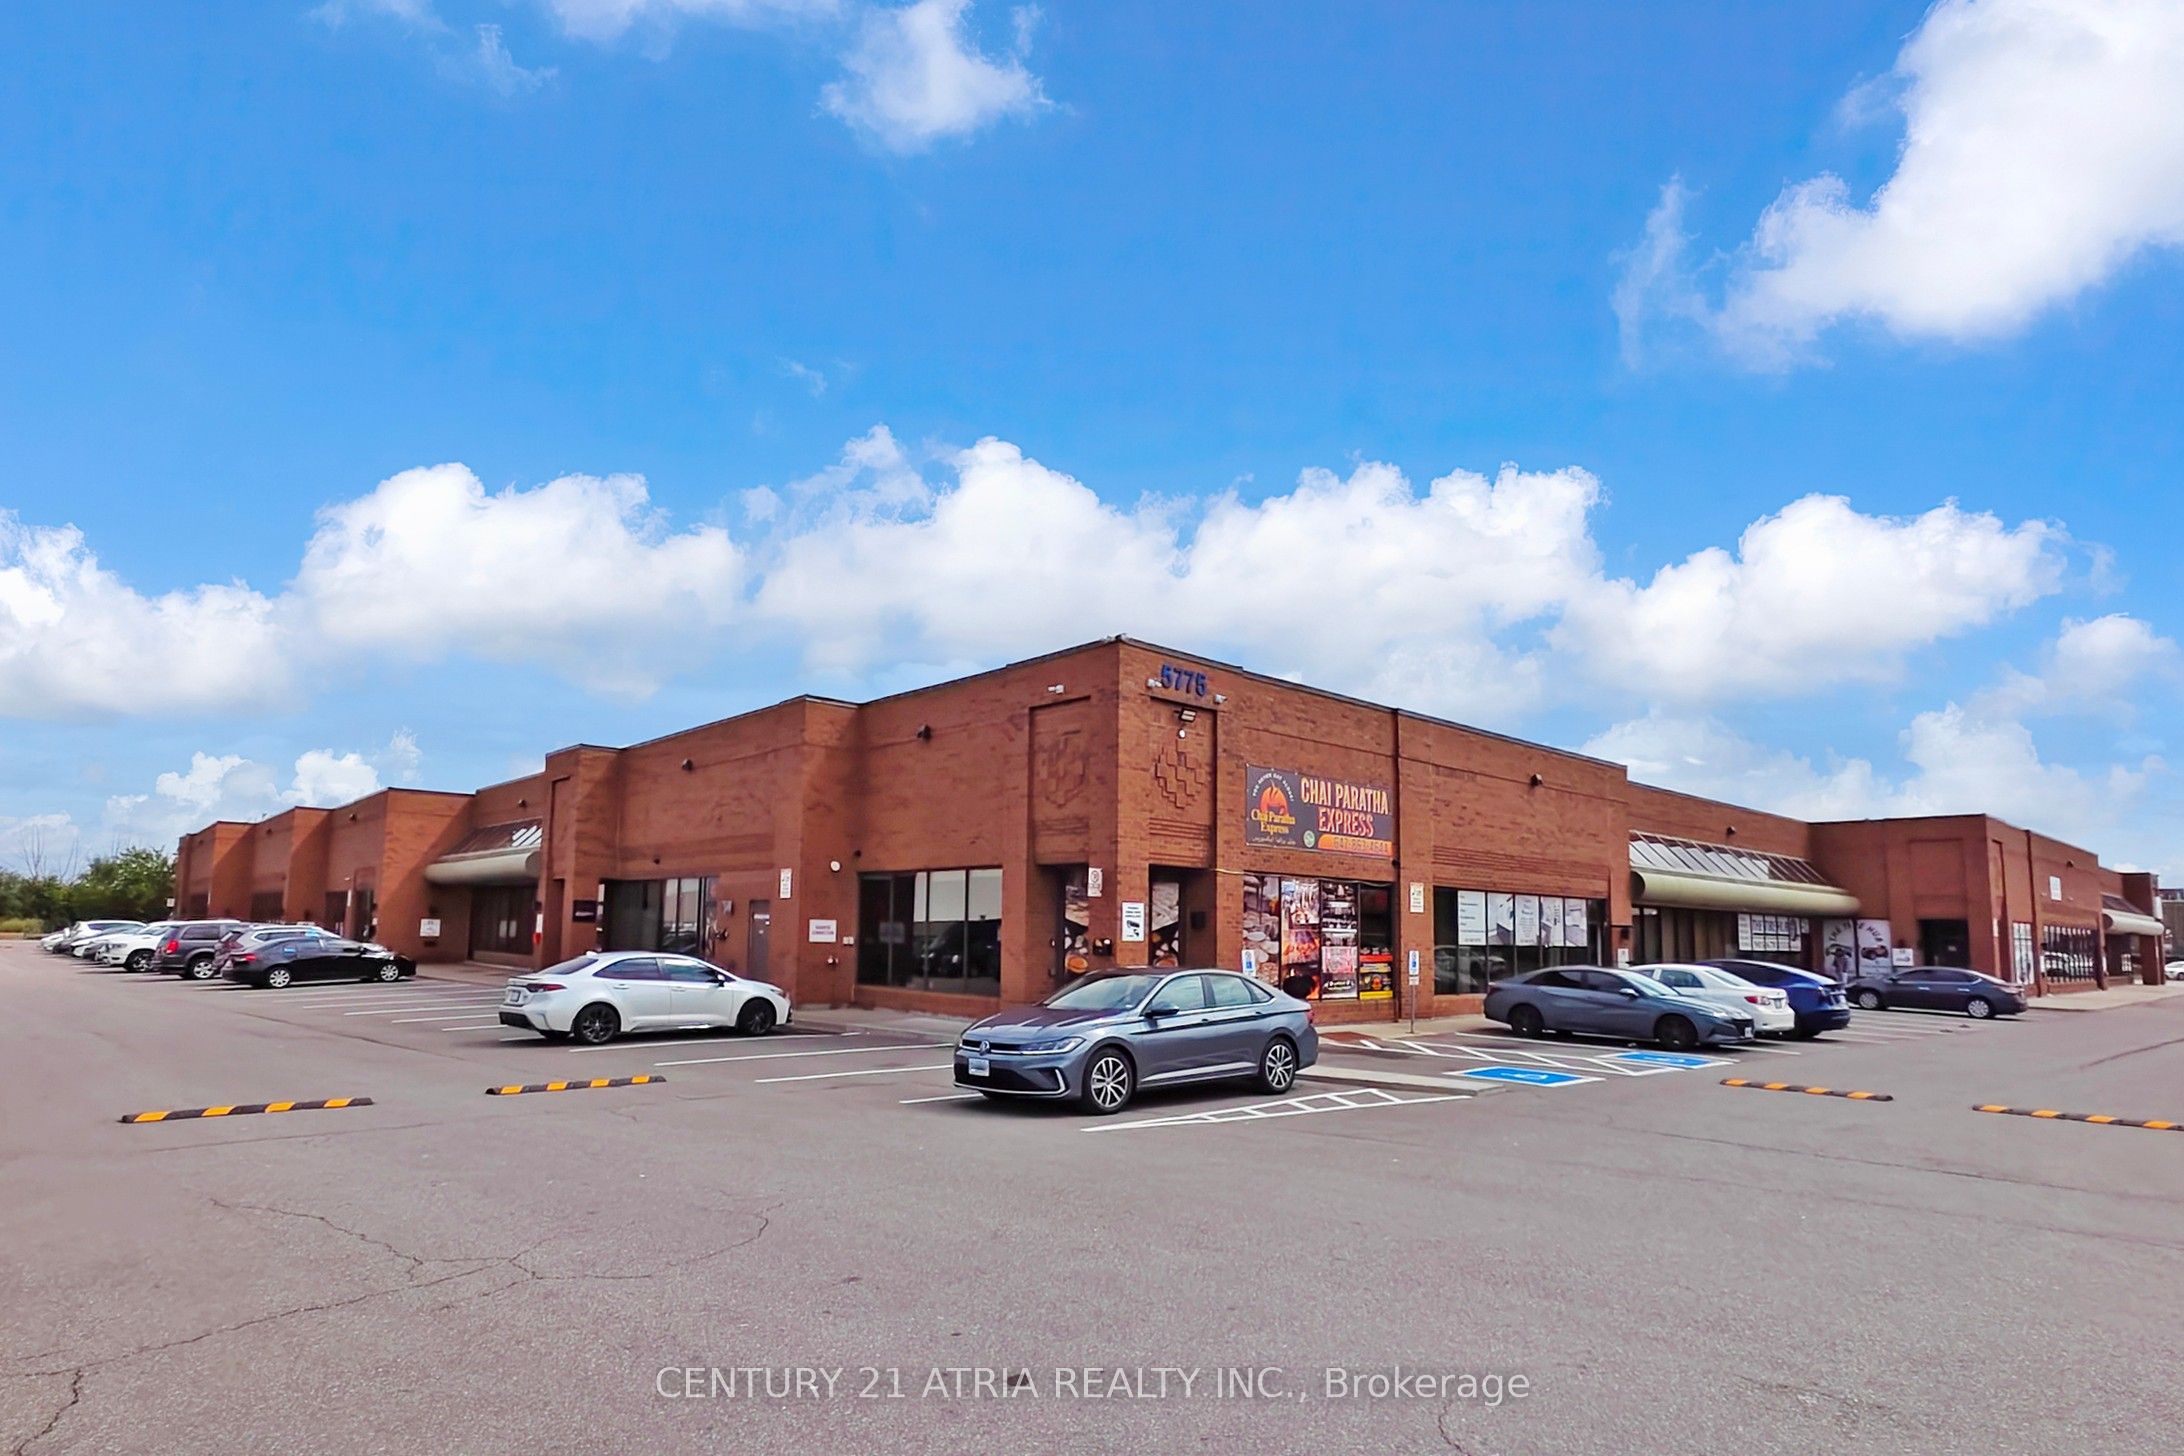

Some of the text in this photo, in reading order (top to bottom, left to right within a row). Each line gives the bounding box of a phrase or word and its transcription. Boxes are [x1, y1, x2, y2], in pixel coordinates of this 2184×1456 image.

[1161, 664, 1206, 697] 5775
[1301, 777, 1390, 815] CHAI PARATHA
[1318, 807, 1375, 838] EXPRESS
